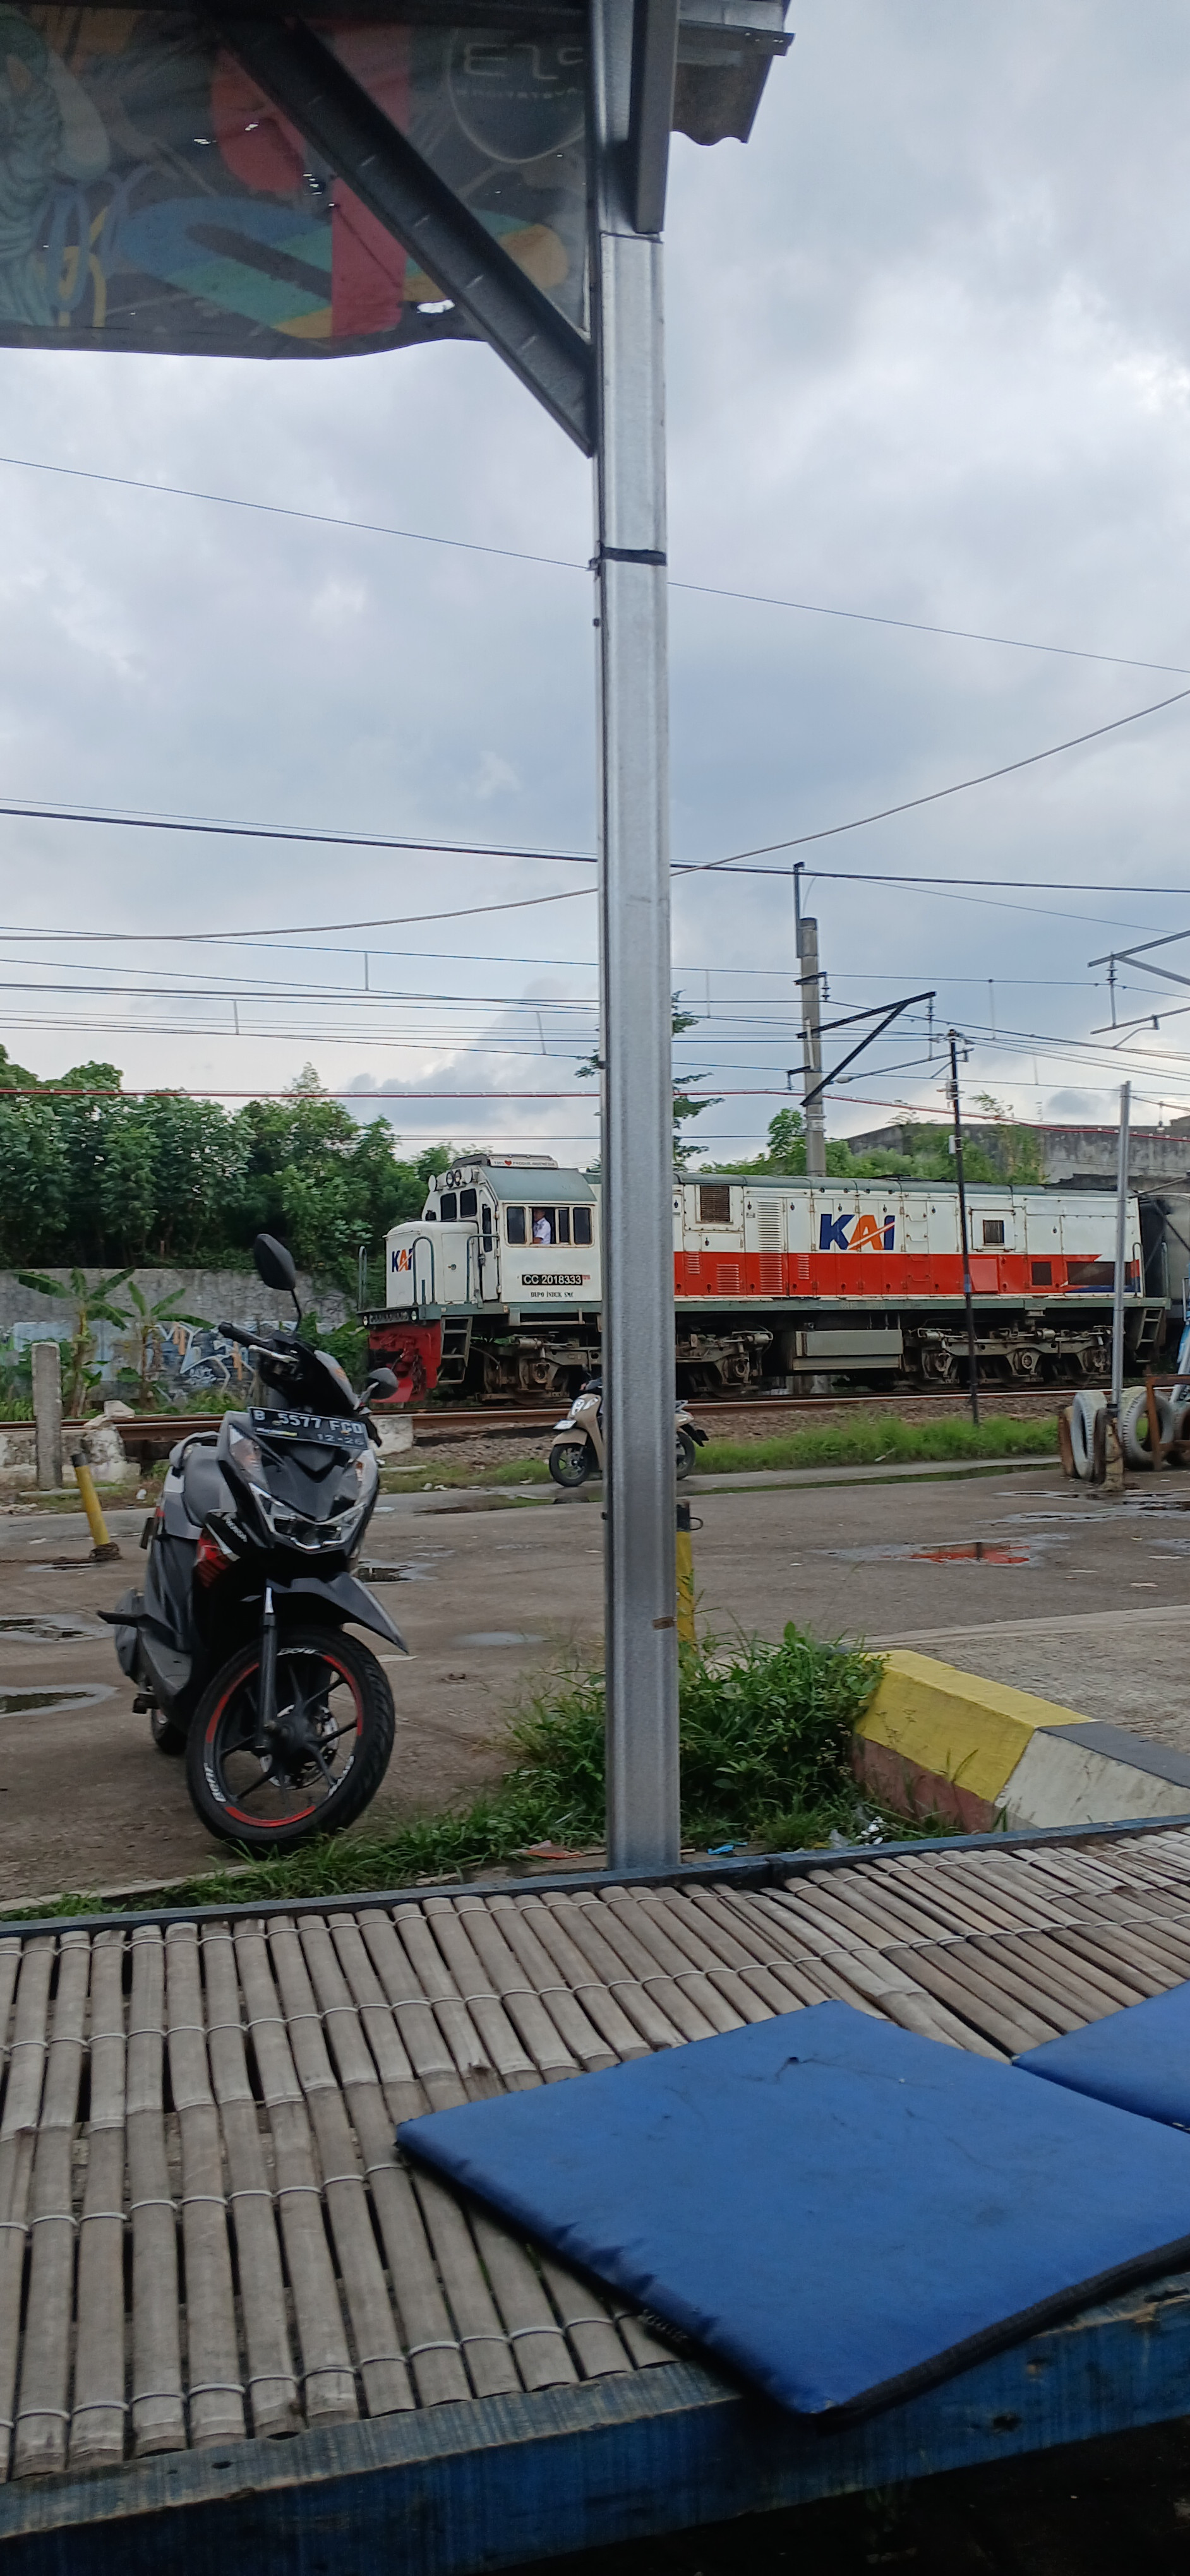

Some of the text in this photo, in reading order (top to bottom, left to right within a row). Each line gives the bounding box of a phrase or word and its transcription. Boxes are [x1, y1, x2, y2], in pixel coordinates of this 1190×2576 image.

[819, 1213, 895, 1250] KAI
[392, 1248, 414, 1272] KAI
[524, 1275, 539, 1284] CC
[541, 1275, 582, 1284] 2018333
[253, 1410, 265, 1421] B
[278, 1413, 322, 1429] 5577
[317, 1433, 364, 1445] 12-26
